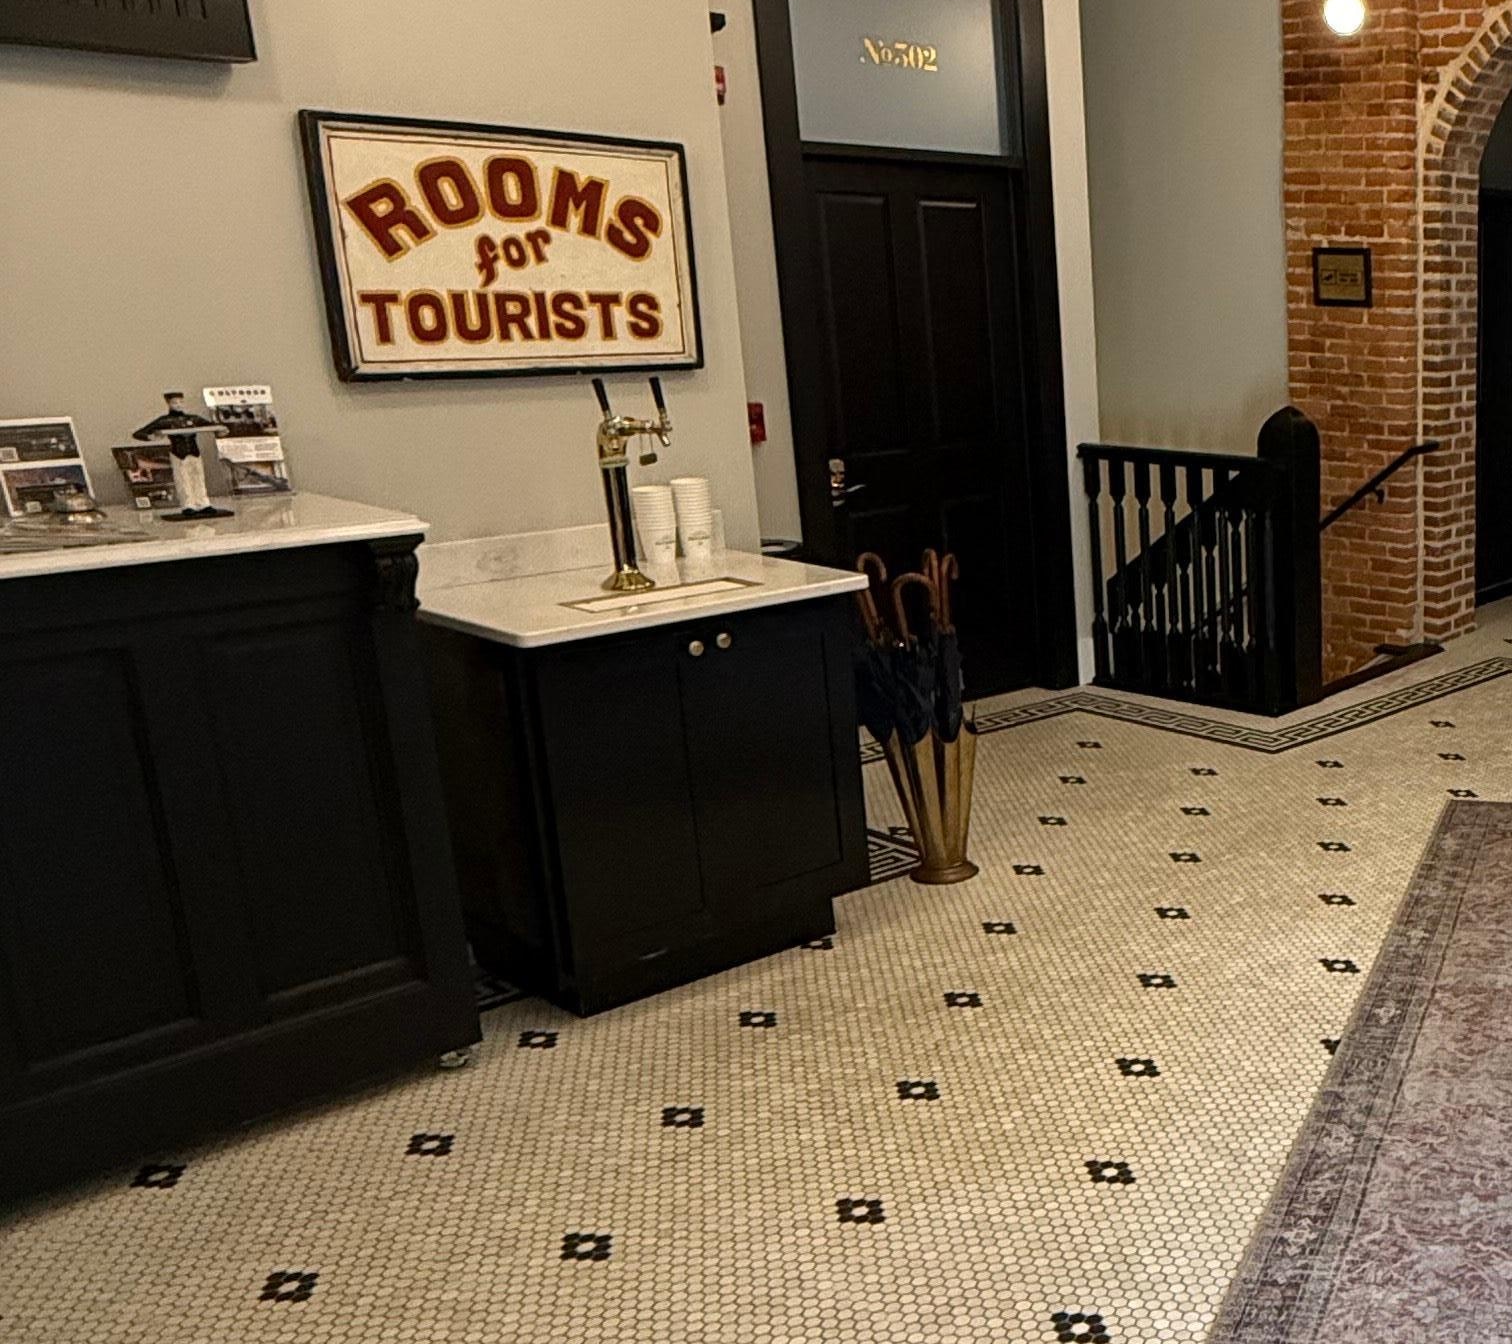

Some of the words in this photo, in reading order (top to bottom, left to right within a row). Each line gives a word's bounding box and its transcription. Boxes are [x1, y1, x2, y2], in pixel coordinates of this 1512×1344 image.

[341, 154, 663, 263] ROOMS
[475, 226, 552, 288] for
[357, 288, 663, 345] TOURISTS
